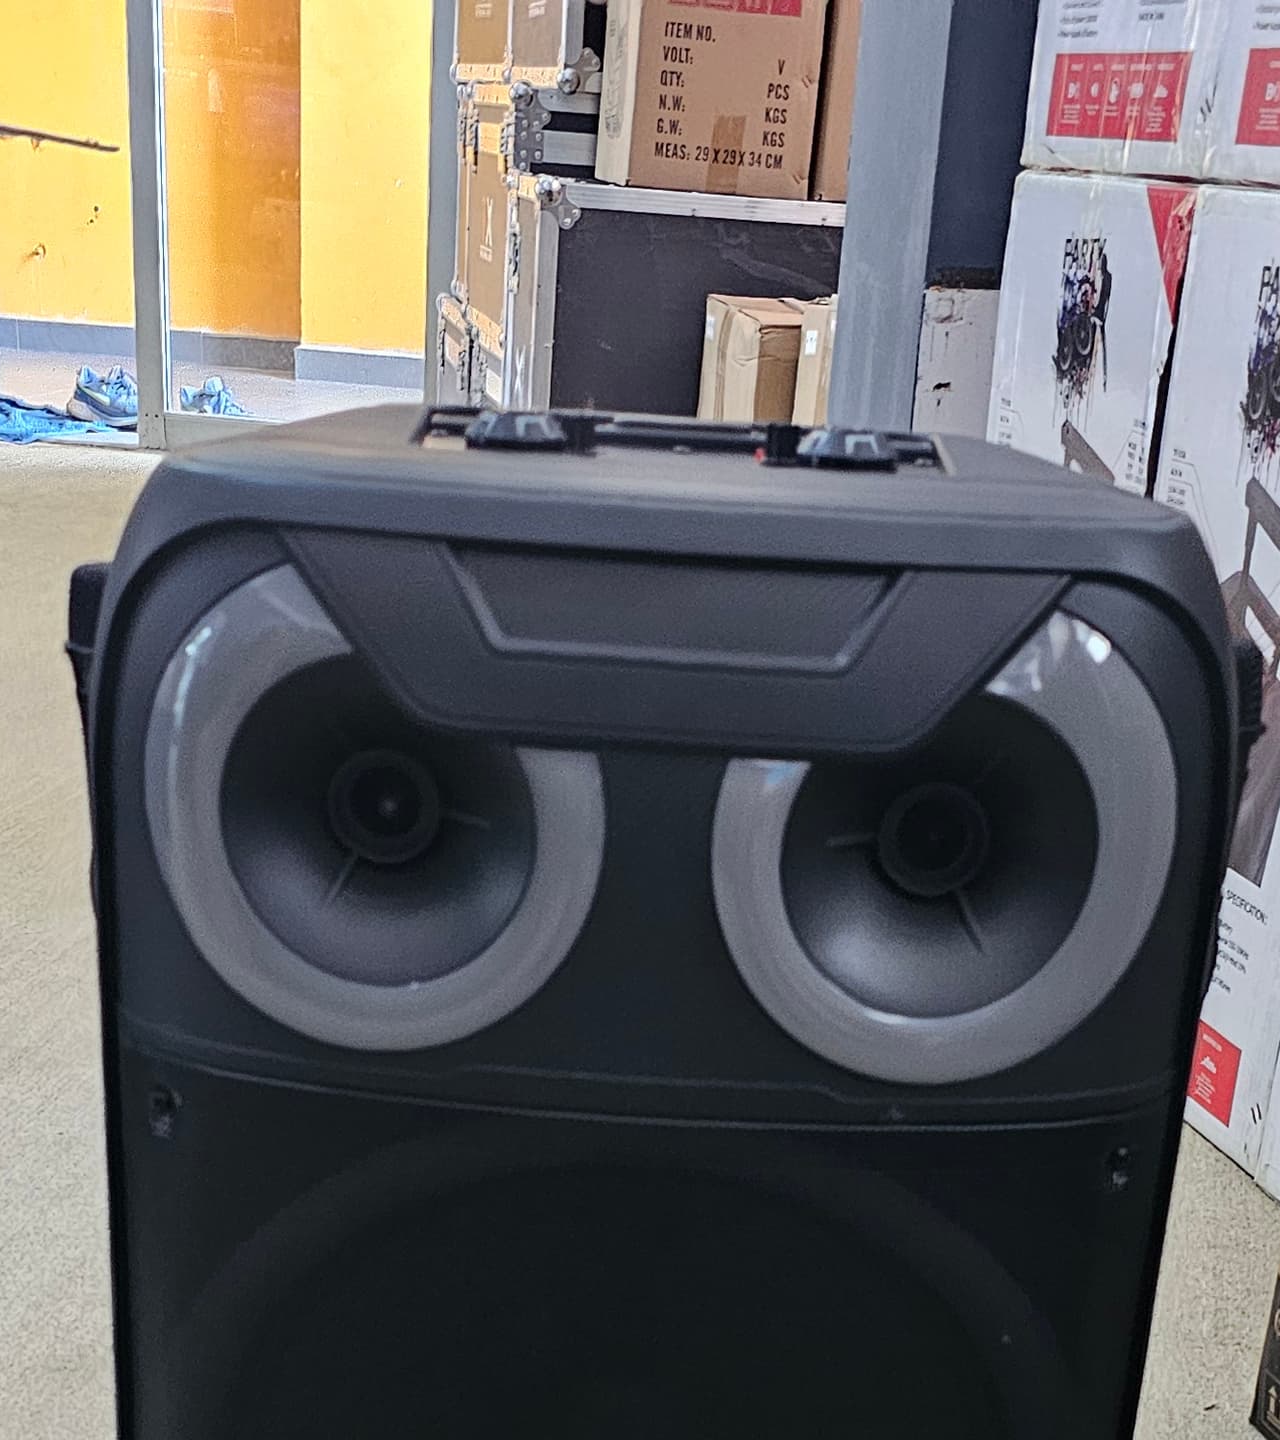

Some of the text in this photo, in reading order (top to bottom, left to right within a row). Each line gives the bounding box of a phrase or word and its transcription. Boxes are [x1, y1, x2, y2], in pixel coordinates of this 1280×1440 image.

[664, 21, 716, 42] ITEM NO.
[663, 46, 693, 65] VOLT:
[777, 59, 786, 76] V
[660, 70, 685, 88] QTY:
[767, 83, 790, 101] PCS
[658, 94, 686, 112] N.W:
[764, 107, 787, 124] KGS
[656, 118, 682, 136] G.W:
[762, 131, 785, 148] KGS
[654, 142, 690, 161] MEAS:
[748, 152, 762, 168] 34
[765, 153, 783, 169] CM
[1063, 237, 1108, 269] PARTY
